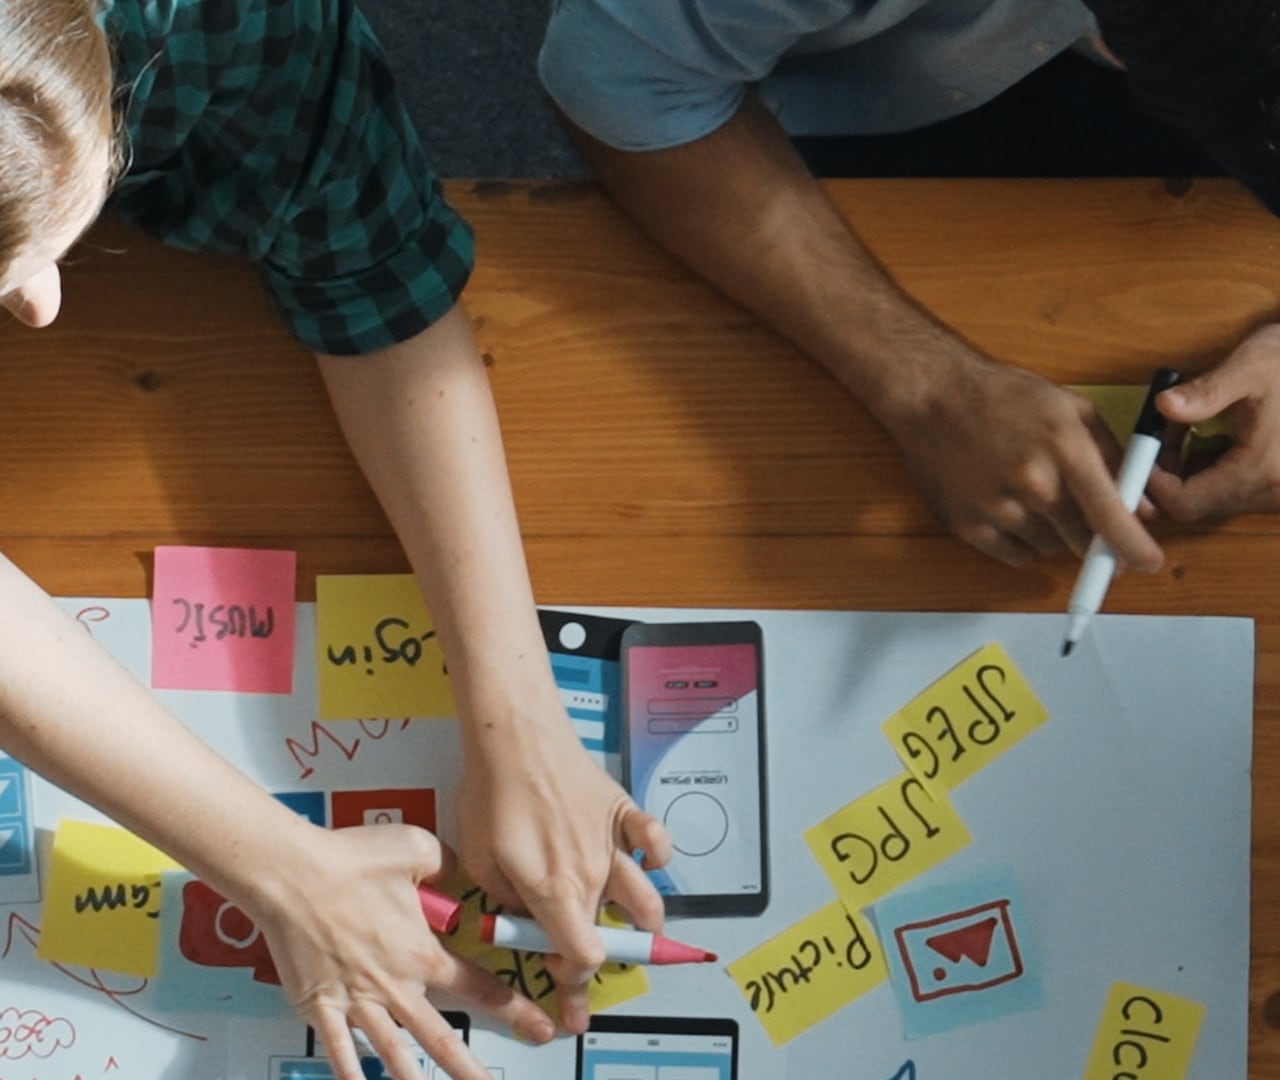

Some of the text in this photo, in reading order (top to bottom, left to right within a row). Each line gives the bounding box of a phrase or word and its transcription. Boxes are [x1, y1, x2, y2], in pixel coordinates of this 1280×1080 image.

[327, 617, 449, 676] ogin
[902, 664, 1017, 780] JPEG
[830, 776, 941, 885] JPG
[745, 914, 872, 1013] Picture
